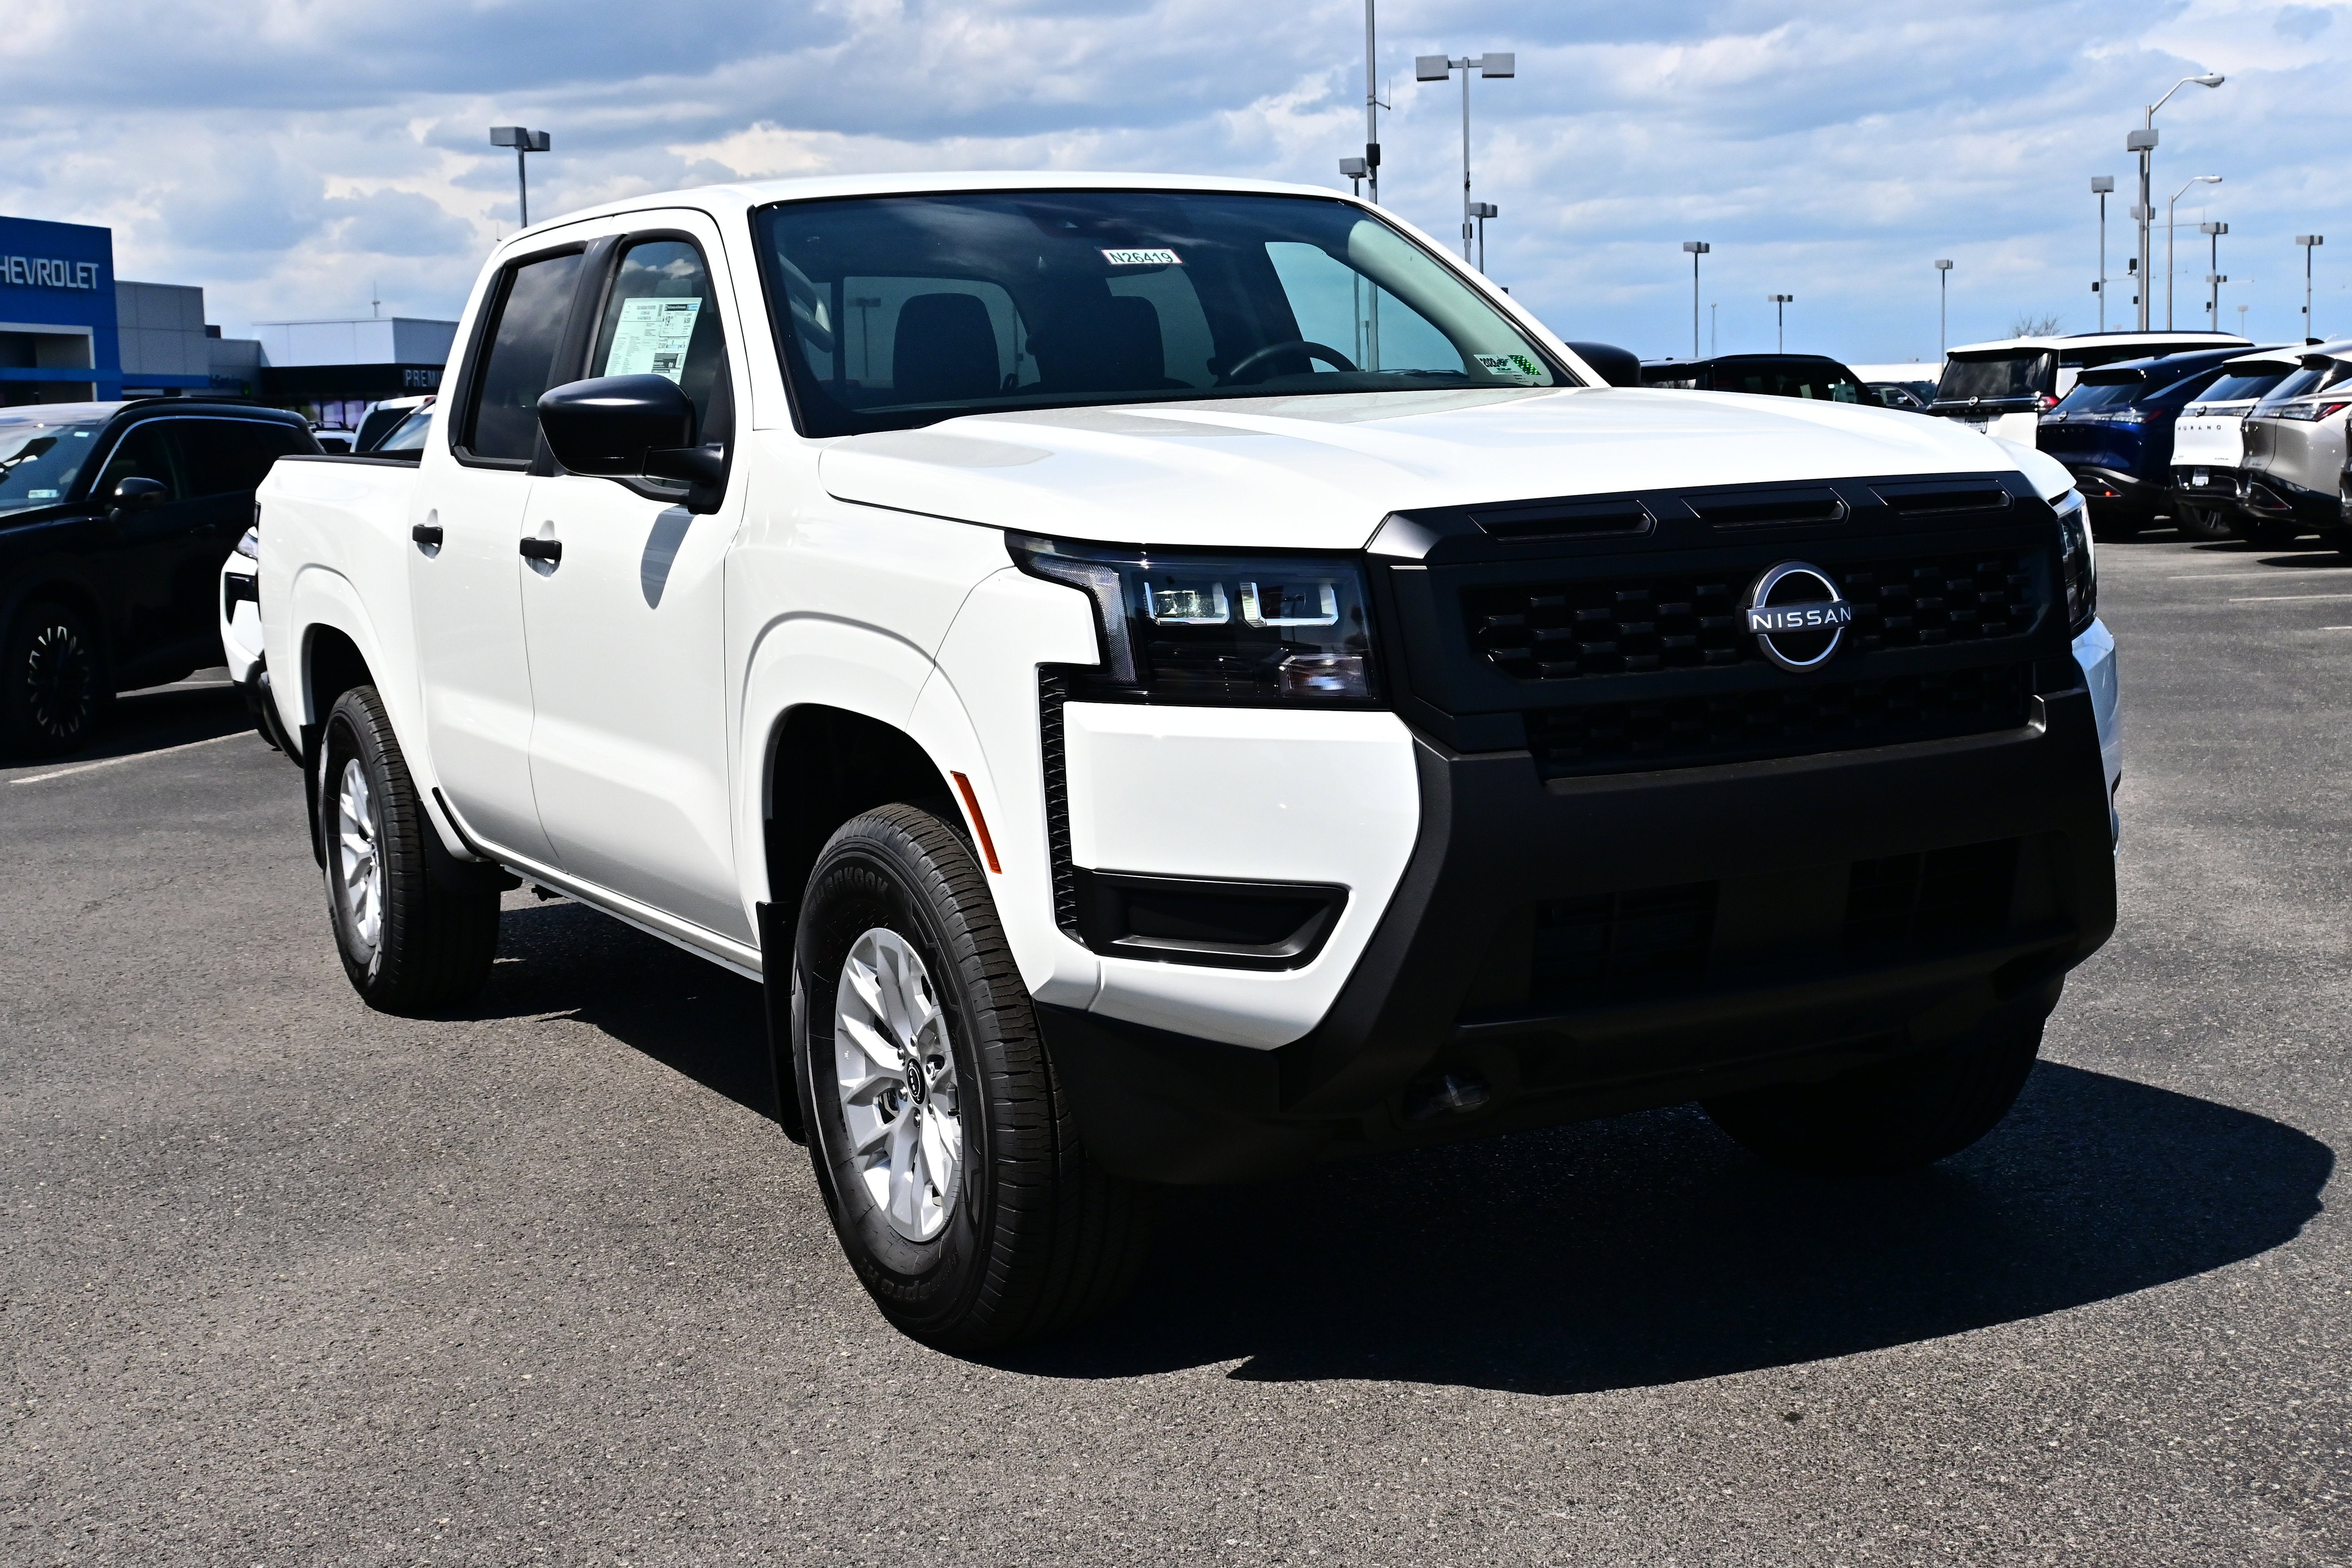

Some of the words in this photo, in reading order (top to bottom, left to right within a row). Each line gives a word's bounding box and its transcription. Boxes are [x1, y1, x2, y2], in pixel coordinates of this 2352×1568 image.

[1109, 252, 1173, 263] N26419
[665, 316, 670, 327] 19
[1753, 606, 1851, 629] NISSAN
